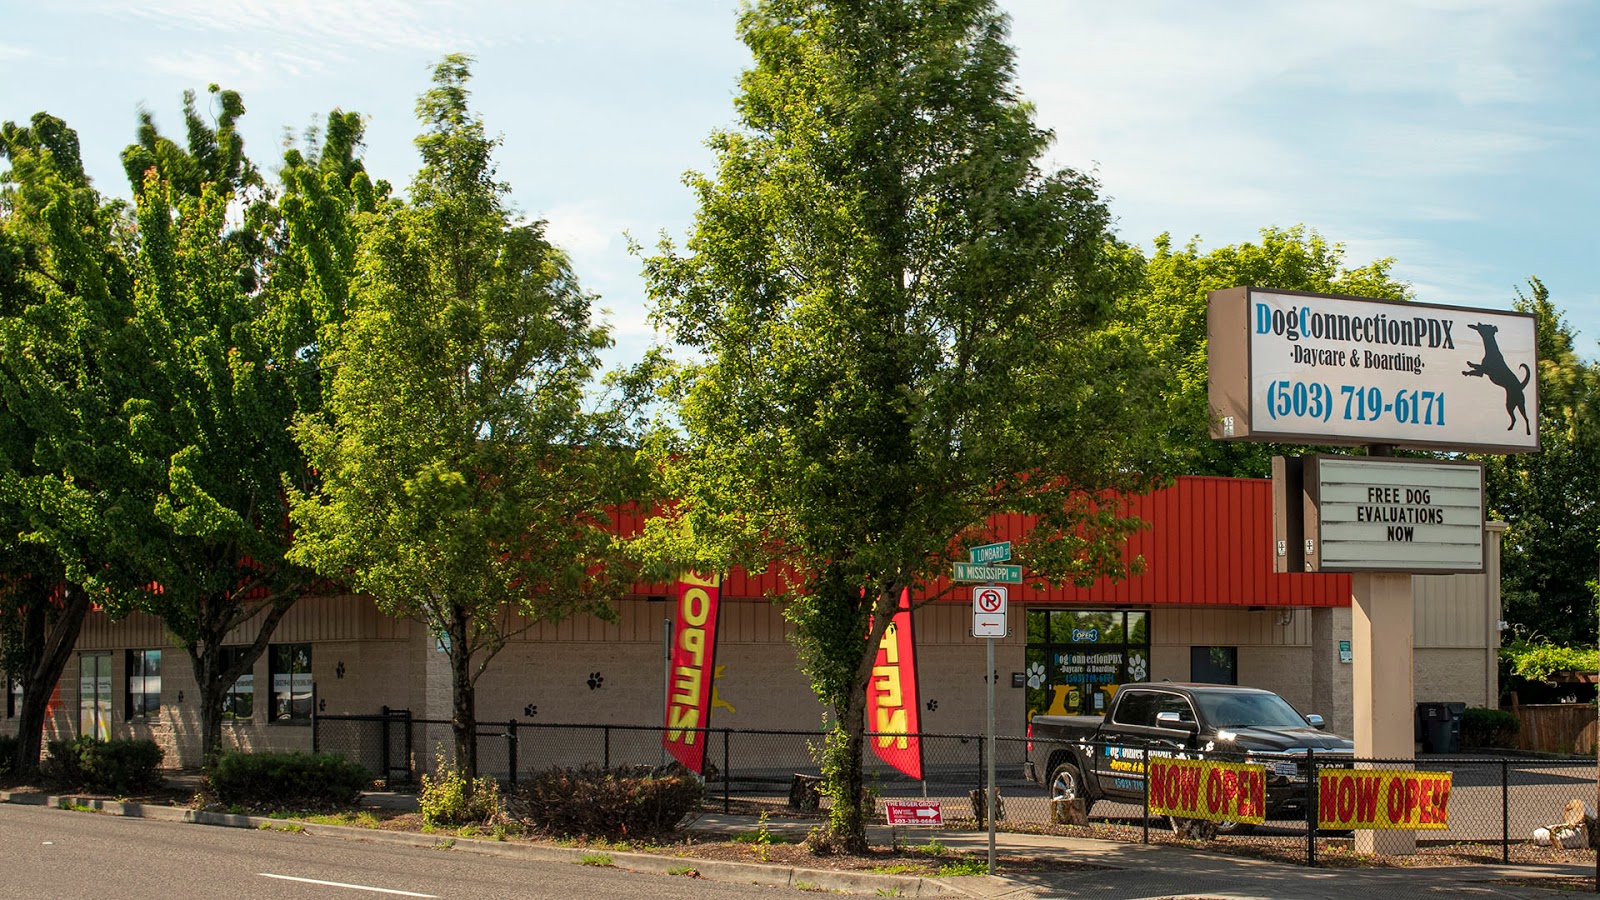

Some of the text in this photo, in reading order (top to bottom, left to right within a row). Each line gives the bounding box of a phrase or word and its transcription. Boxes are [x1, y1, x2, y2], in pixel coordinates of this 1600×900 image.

[1256, 303, 1455, 350] DogConnectionPDX
[1350, 349, 1360, 368] &
[1267, 379, 1446, 426] (503) 719-6171
[1368, 487, 1431, 504] FREE DOG
[1357, 506, 1444, 524] EVALUATIONS
[1387, 526, 1414, 542] NOW
[977, 546, 1004, 562] LOMBARD
[958, 566, 964, 578] N
[967, 566, 1009, 580] MISSISSIPPI
[1054, 653, 1123, 665] DogConnectionPDX
[1150, 763, 1264, 817] NOW OPEN
[1320, 776, 1451, 823] NOW OPEN
